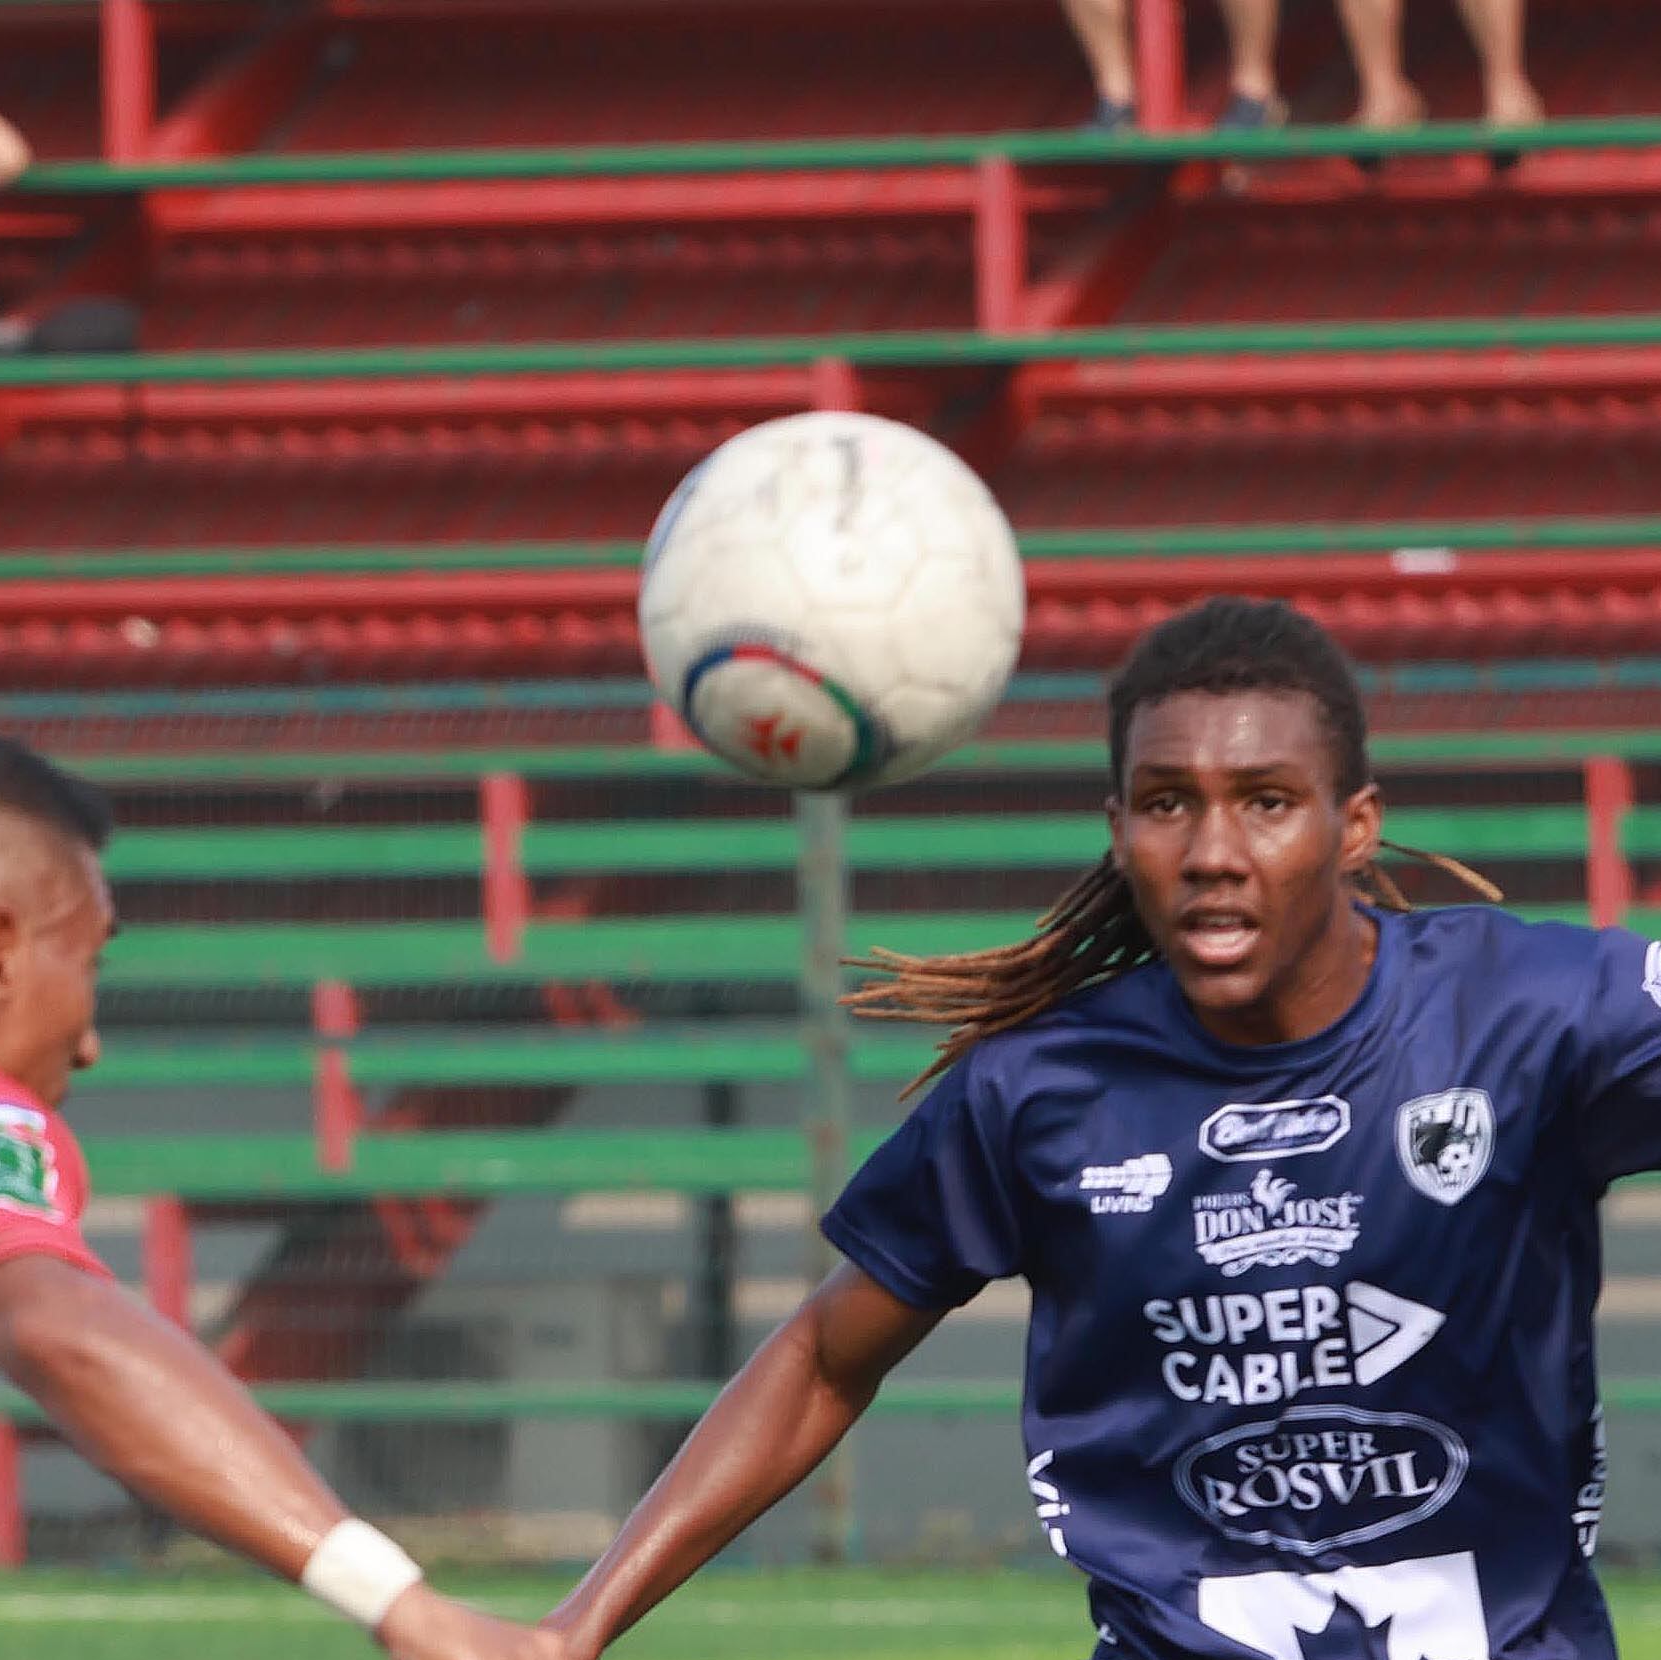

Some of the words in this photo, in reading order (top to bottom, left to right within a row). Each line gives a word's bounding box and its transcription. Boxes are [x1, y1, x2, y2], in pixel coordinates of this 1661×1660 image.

[1194, 1205, 1266, 1245] DON
[1143, 1285, 1341, 1346] SUPER
[1161, 1336, 1354, 1406] CABLE
[1234, 1430, 1379, 1474] SUPER
[1200, 1449, 1439, 1518] ROSVIL
